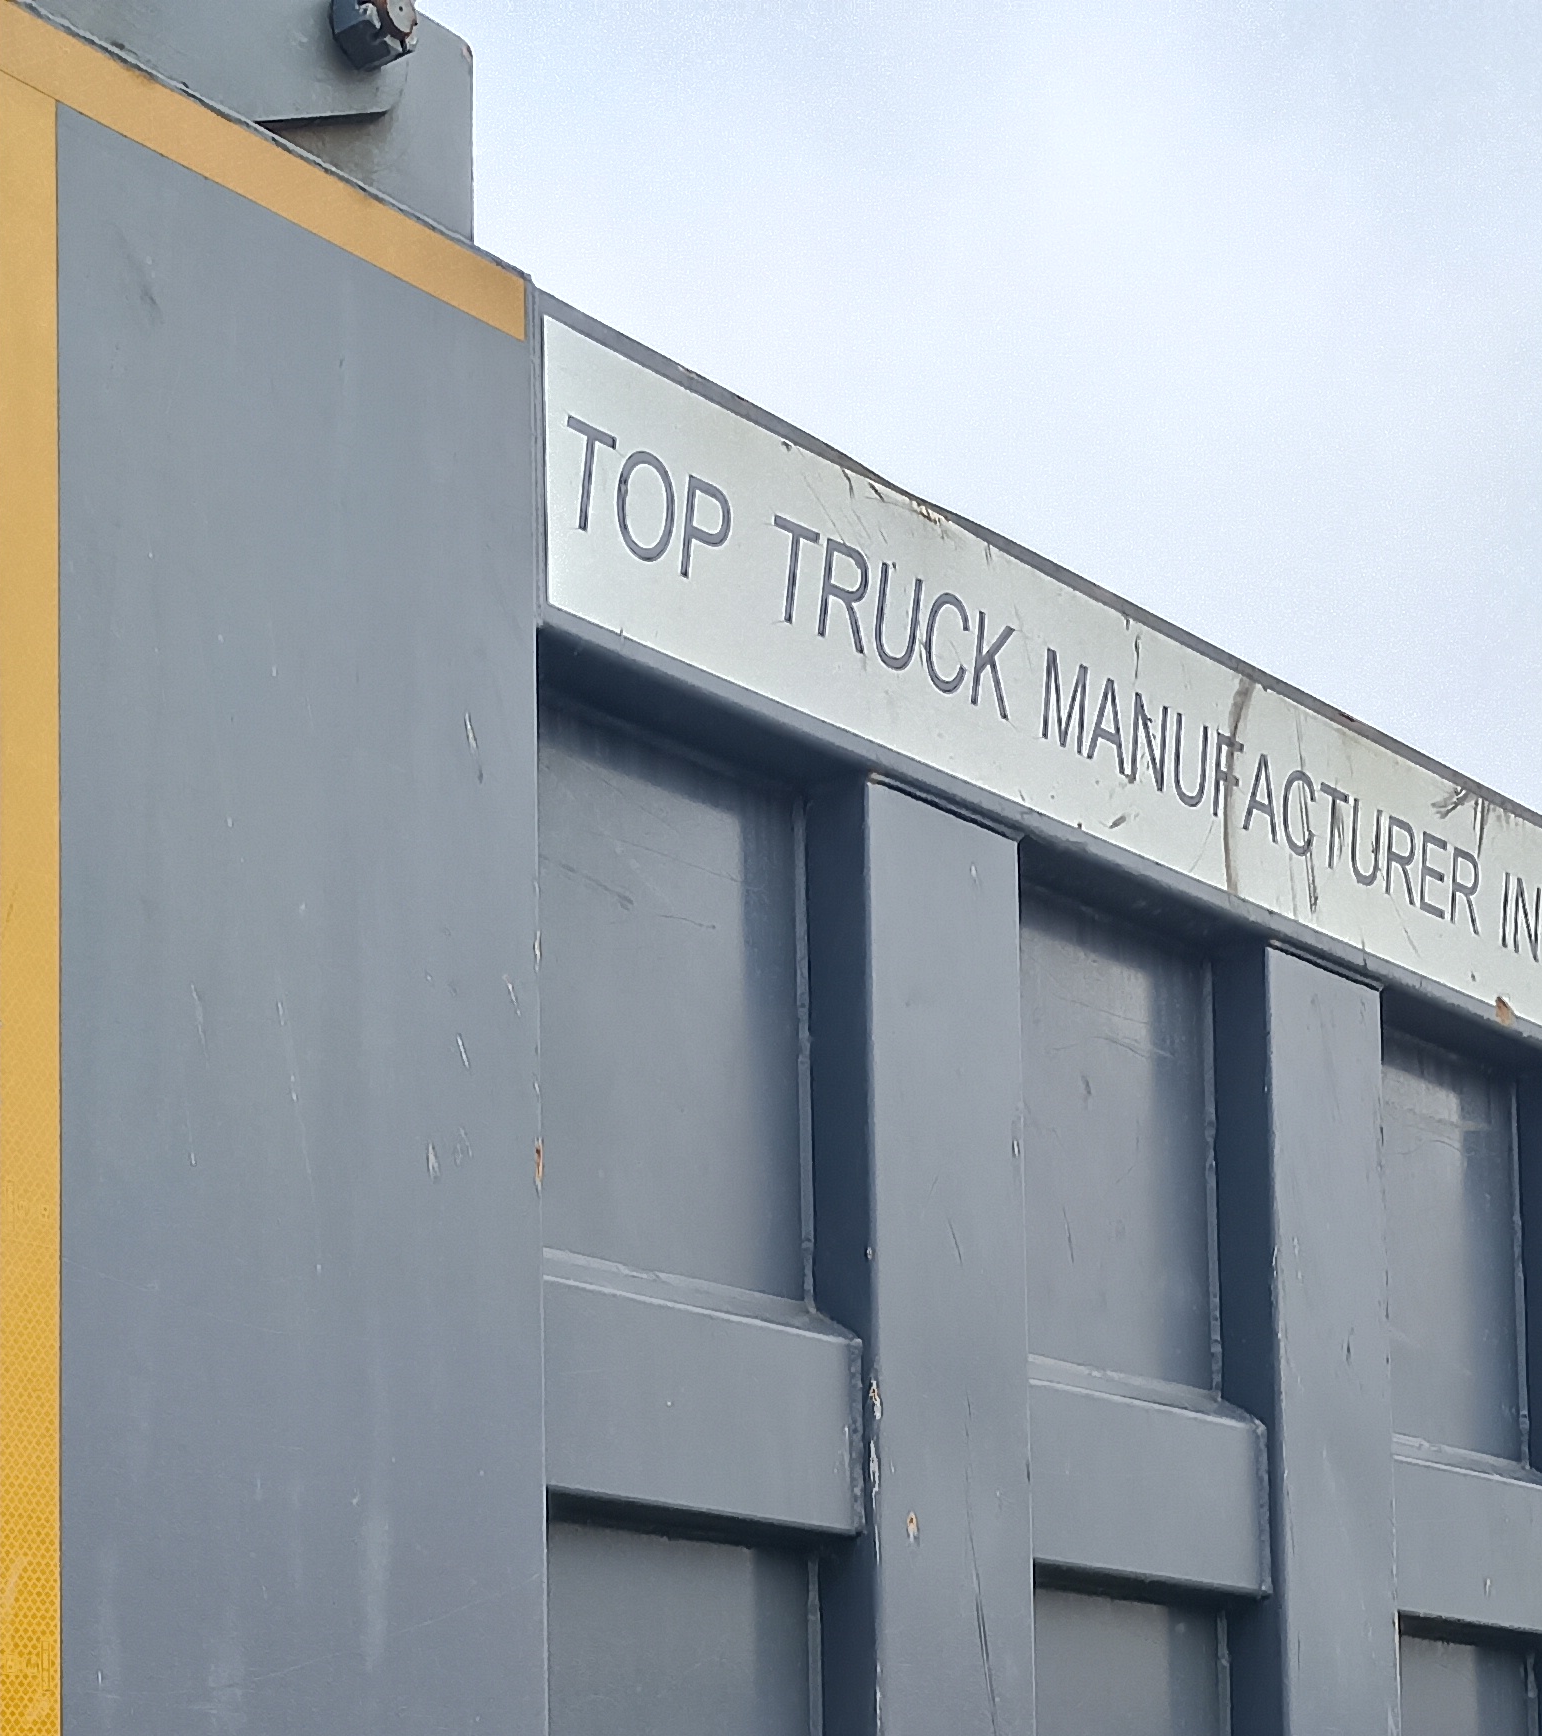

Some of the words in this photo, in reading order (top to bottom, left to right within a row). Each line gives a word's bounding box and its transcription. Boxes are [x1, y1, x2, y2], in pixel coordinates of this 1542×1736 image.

[565, 414, 732, 580] TOP
[773, 514, 1016, 721] TRUCK
[1041, 647, 1480, 935] MANUFACTURER
[1500, 871, 1542, 963] IN
